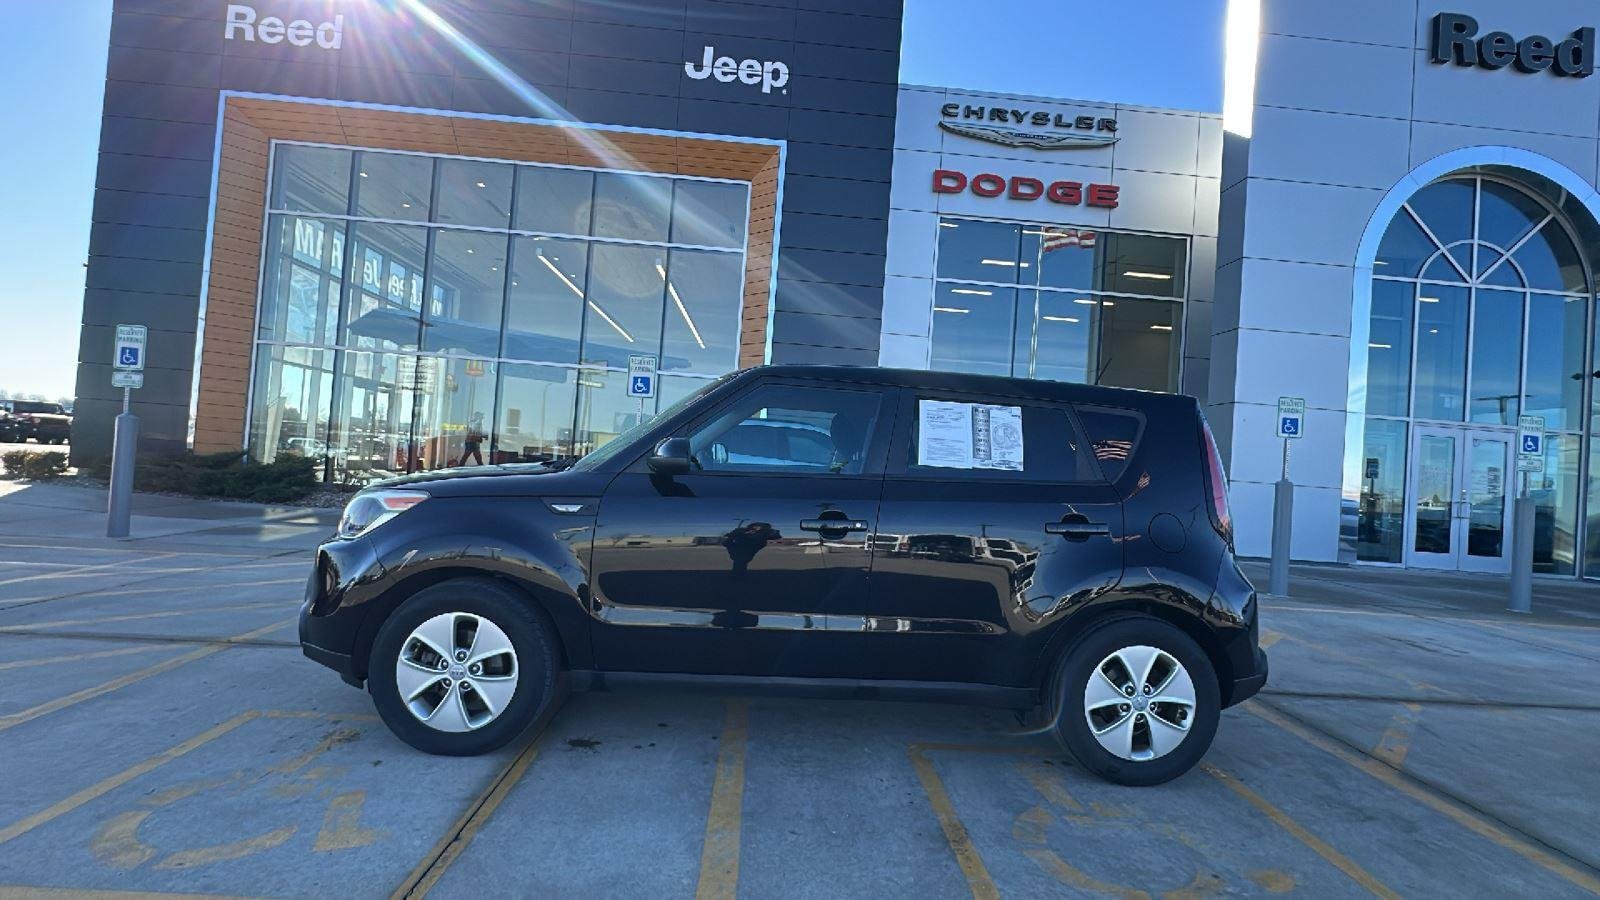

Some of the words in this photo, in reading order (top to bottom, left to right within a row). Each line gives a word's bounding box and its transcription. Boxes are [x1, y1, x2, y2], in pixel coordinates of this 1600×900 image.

[225, 4, 343, 49] Reed
[1431, 12, 1595, 78] Reed
[685, 46, 789, 94] Jeep
[941, 103, 1119, 132] CHRYSLER
[933, 169, 1120, 208] DODGE
